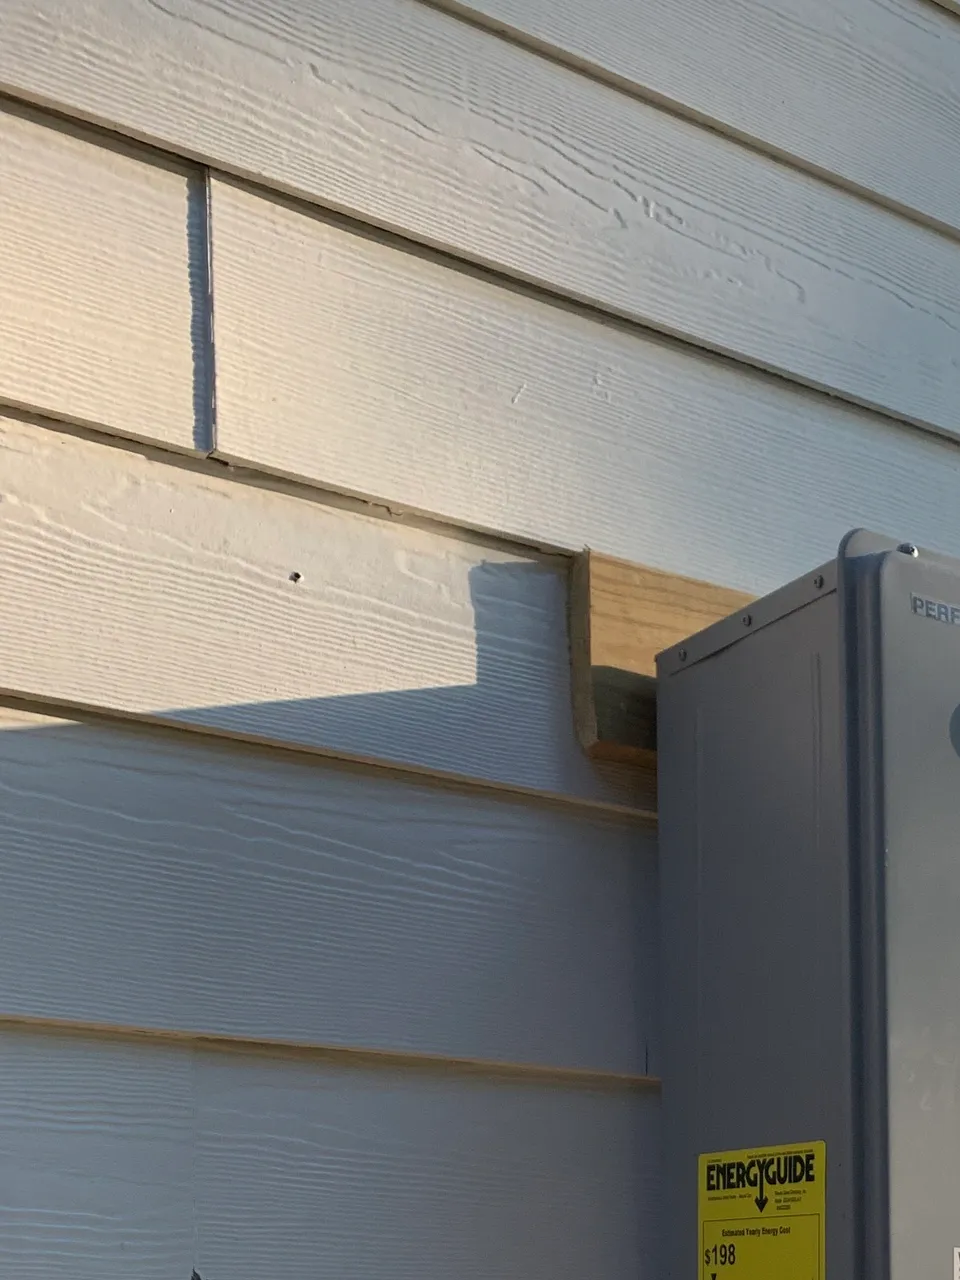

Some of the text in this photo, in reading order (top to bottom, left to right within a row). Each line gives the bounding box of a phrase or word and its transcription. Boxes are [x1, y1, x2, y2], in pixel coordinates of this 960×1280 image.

[706, 1154, 815, 1190] ENERGYGUIDE
[721, 1226, 791, 1237] Estimated Yearly Energy Cost
[704, 1243, 737, 1266] $198
